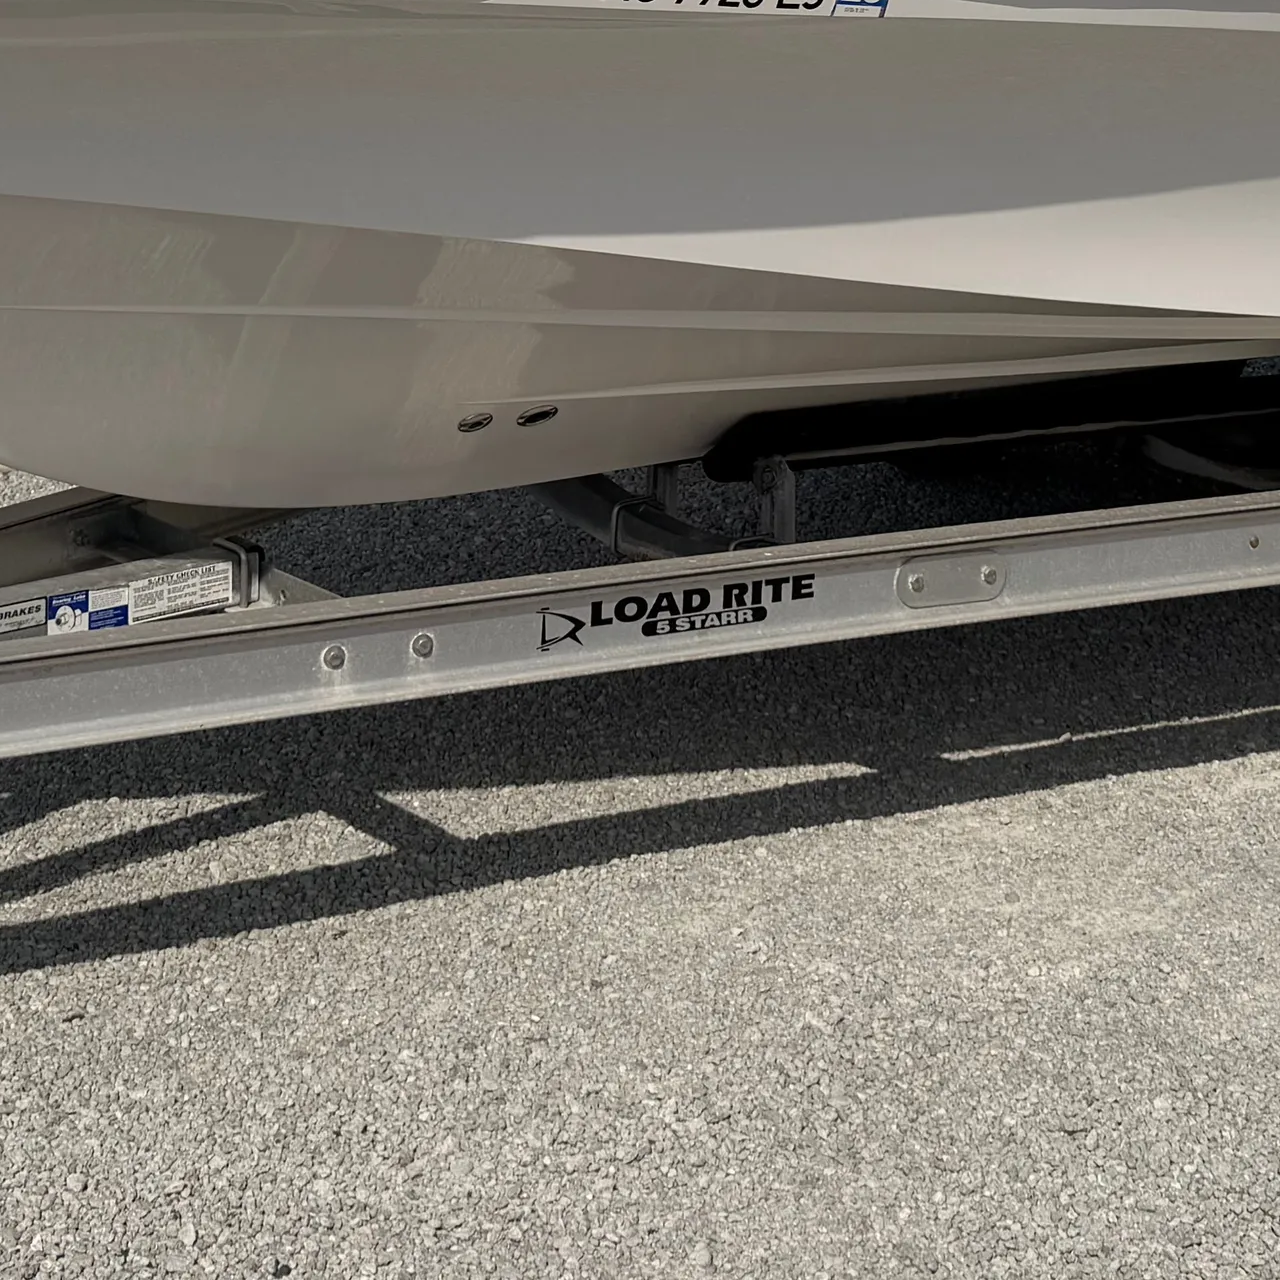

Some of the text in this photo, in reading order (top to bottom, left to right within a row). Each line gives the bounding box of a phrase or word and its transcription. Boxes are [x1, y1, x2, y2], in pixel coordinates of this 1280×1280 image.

[590, 573, 816, 627] LOAD RITE
[656, 608, 754, 634] 5 STARR
